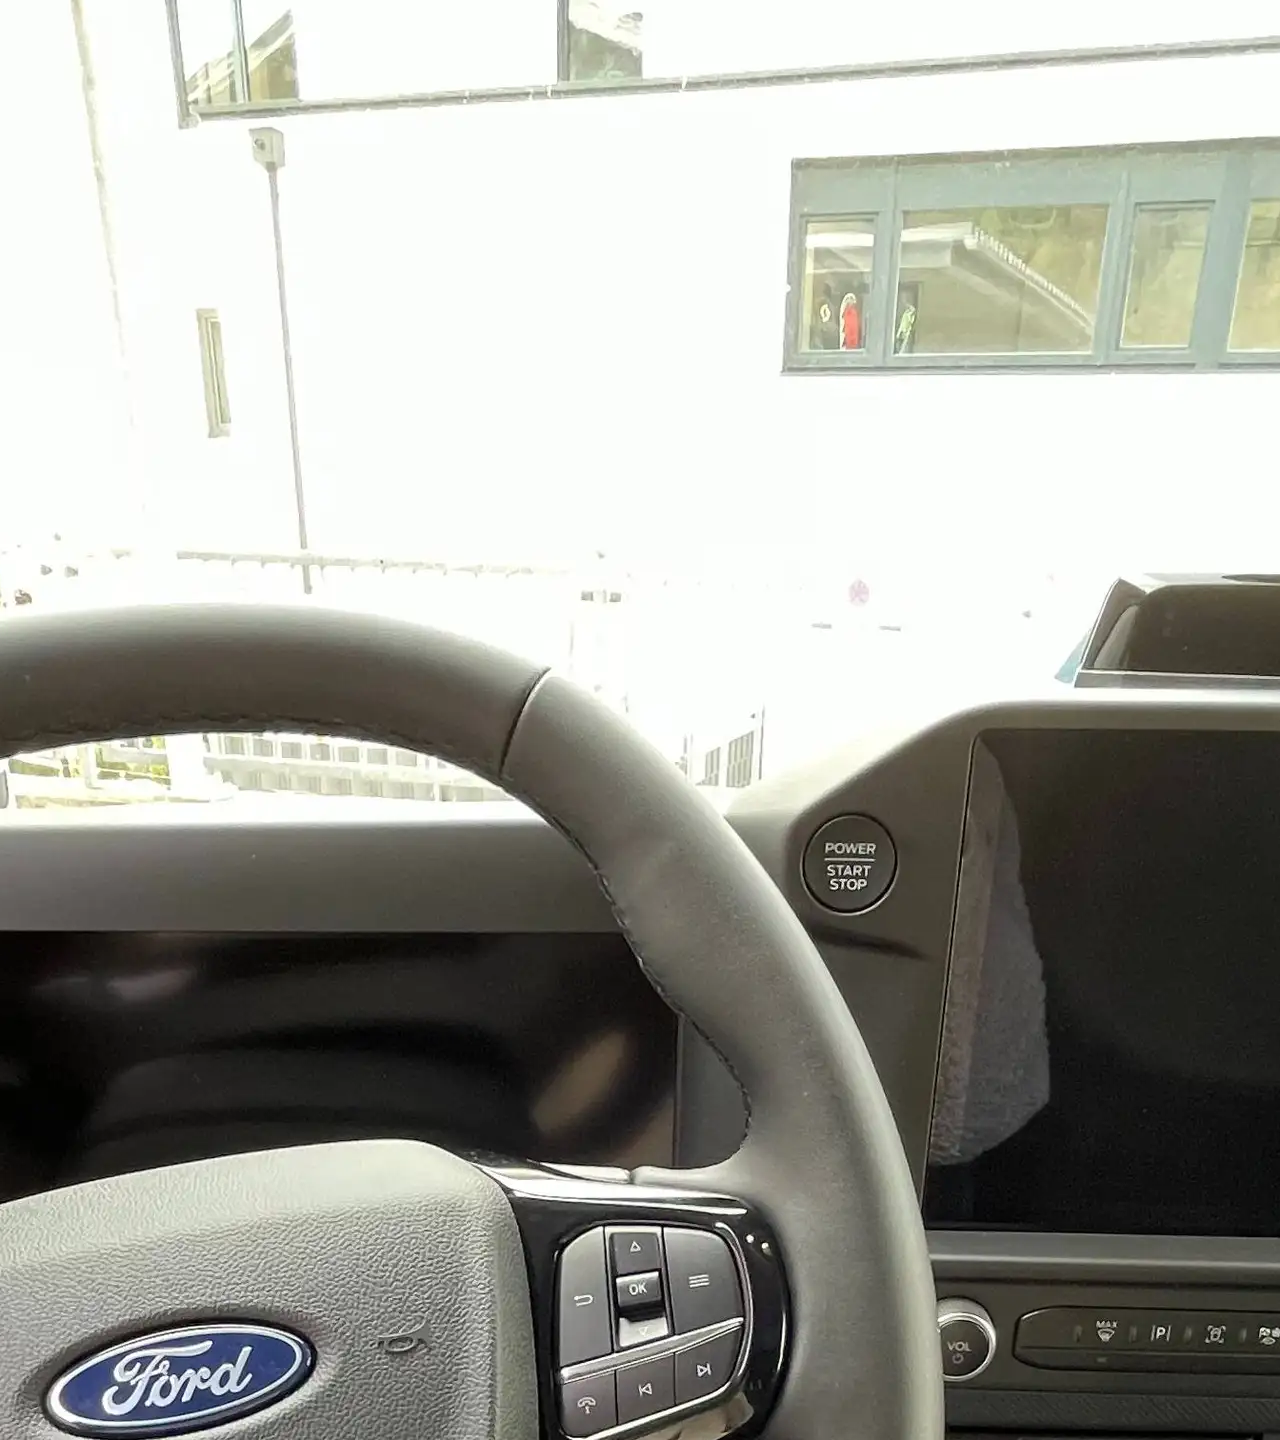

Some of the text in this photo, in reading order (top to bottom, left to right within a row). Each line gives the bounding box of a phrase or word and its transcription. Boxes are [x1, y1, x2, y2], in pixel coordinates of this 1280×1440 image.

[824, 842, 877, 856] POWER
[826, 864, 871, 878] START
[829, 878, 868, 892] STOP
[628, 1282, 648, 1297] OK
[1095, 1320, 1118, 1329] MAX
[946, 1341, 972, 1352] VOL
[101, 1339, 253, 1416] Ford
